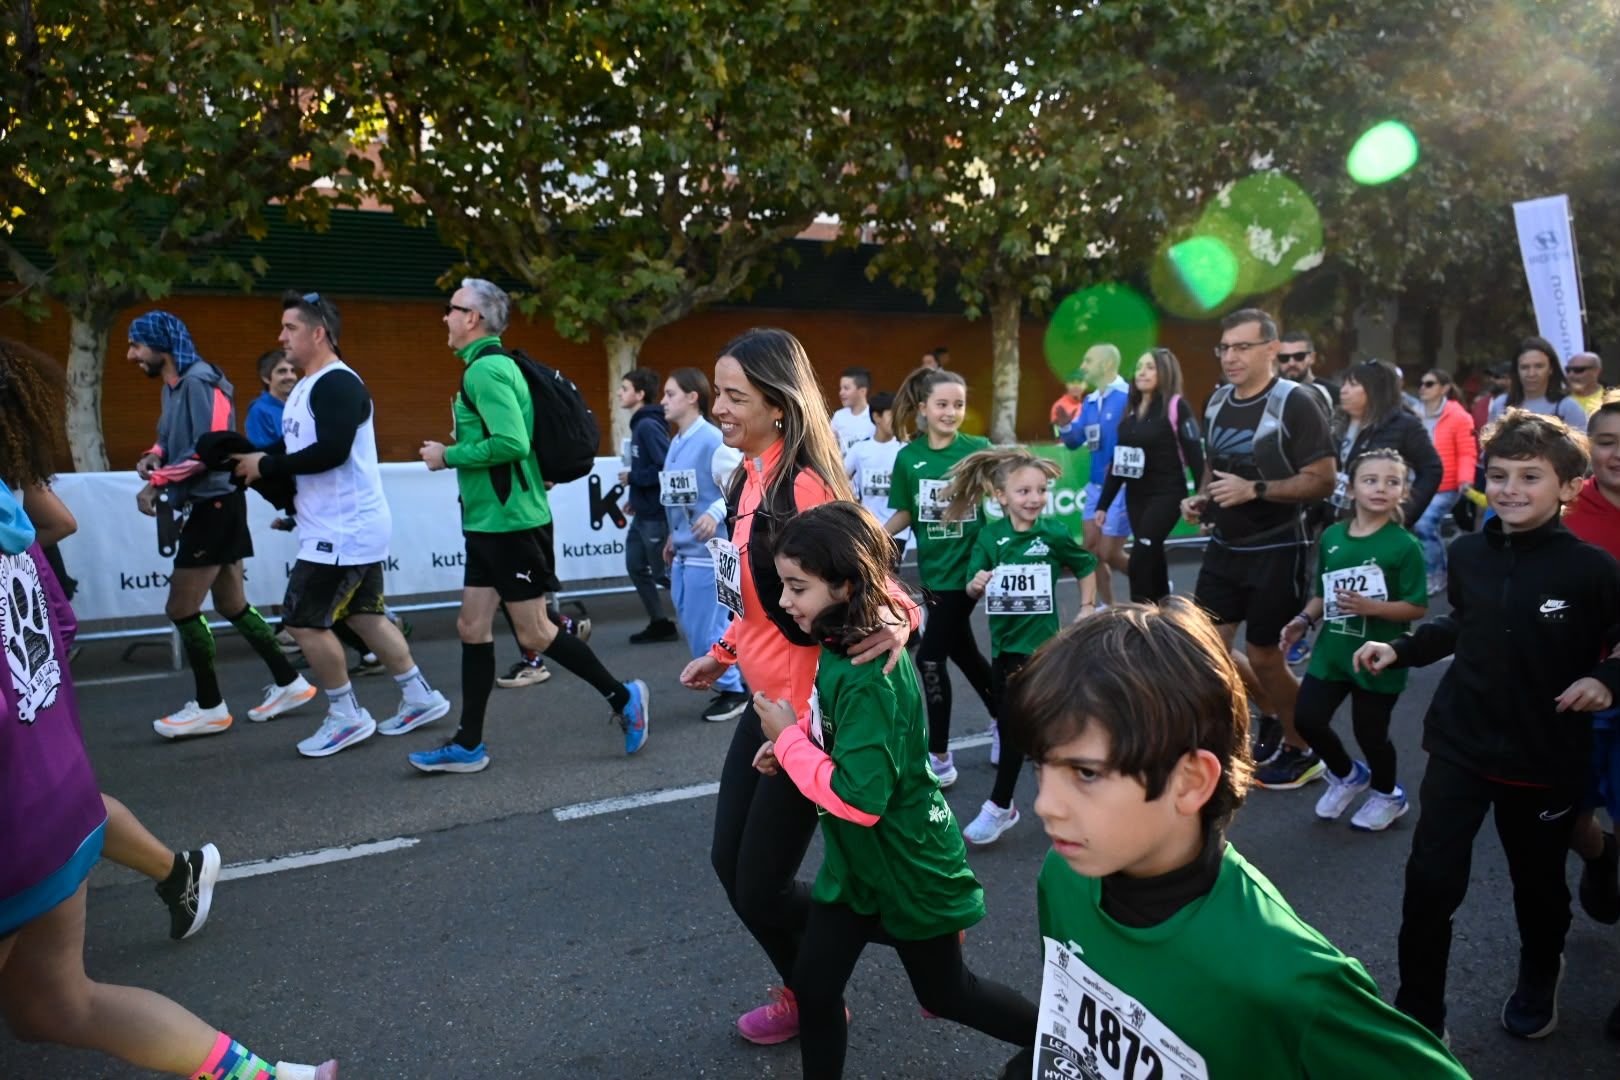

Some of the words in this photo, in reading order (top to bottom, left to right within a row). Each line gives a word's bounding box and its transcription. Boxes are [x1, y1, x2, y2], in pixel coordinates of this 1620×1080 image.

[670, 476, 689, 489] 4201
[563, 540, 624, 557] kutxab
[719, 551, 737, 582] 5387
[1001, 574, 1035, 591] 4781
[1333, 576, 1368, 593] 4722
[1078, 993, 1163, 1080] 4872
